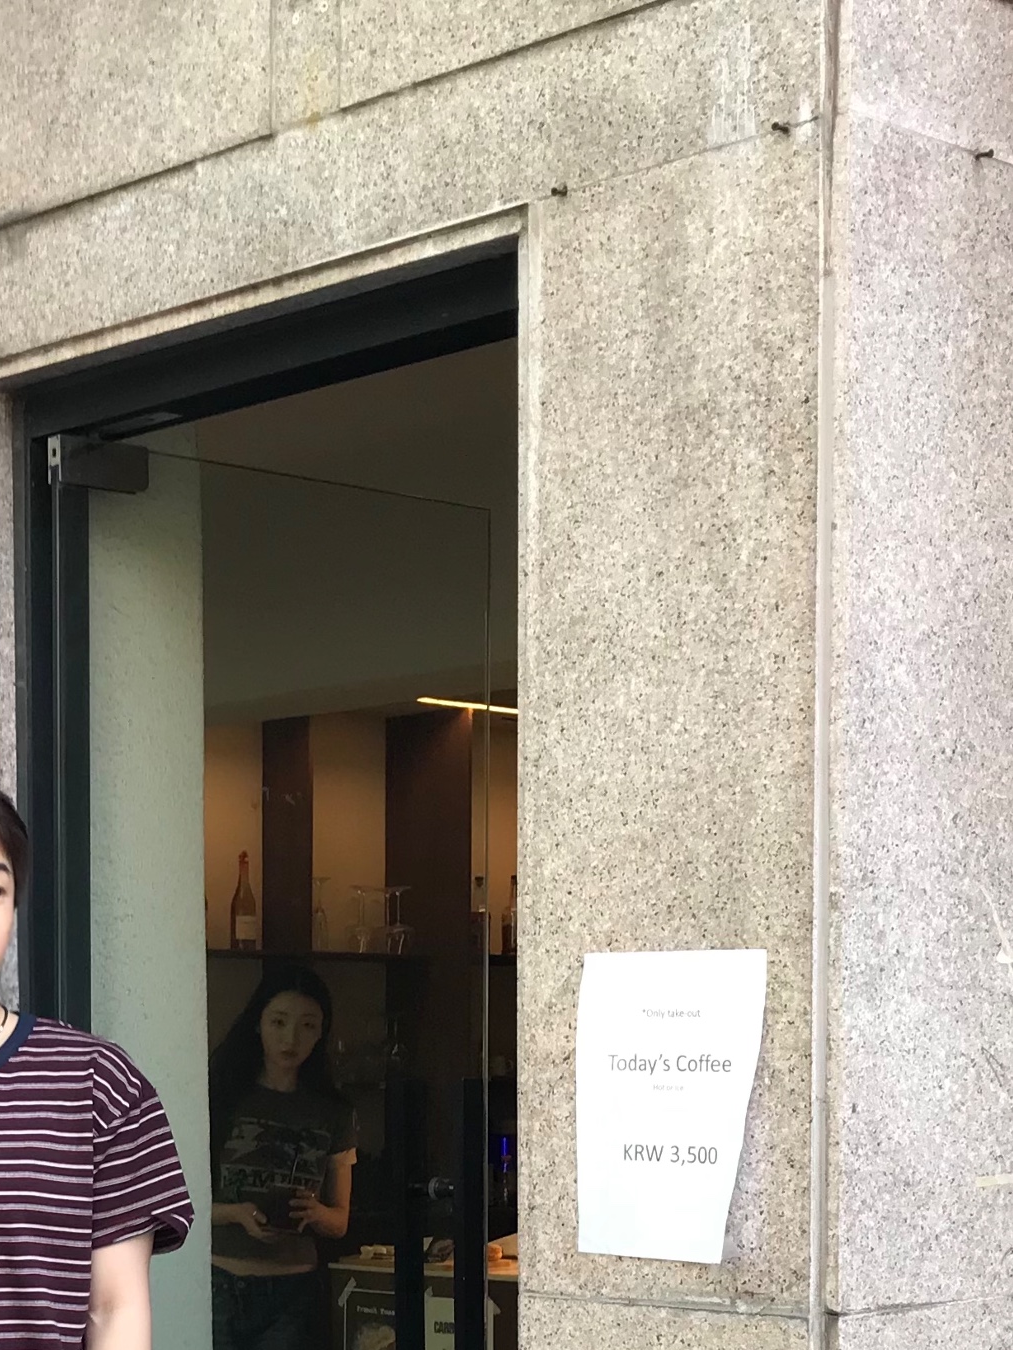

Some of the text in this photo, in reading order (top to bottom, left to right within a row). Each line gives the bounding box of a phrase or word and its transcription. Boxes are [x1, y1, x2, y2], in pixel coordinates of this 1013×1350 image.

[667, 1008, 701, 1018] take-out
[607, 1053, 732, 1076] Today's Coffee
[623, 1143, 718, 1166] KRW 3,500
[433, 1321, 455, 1334] CARR
